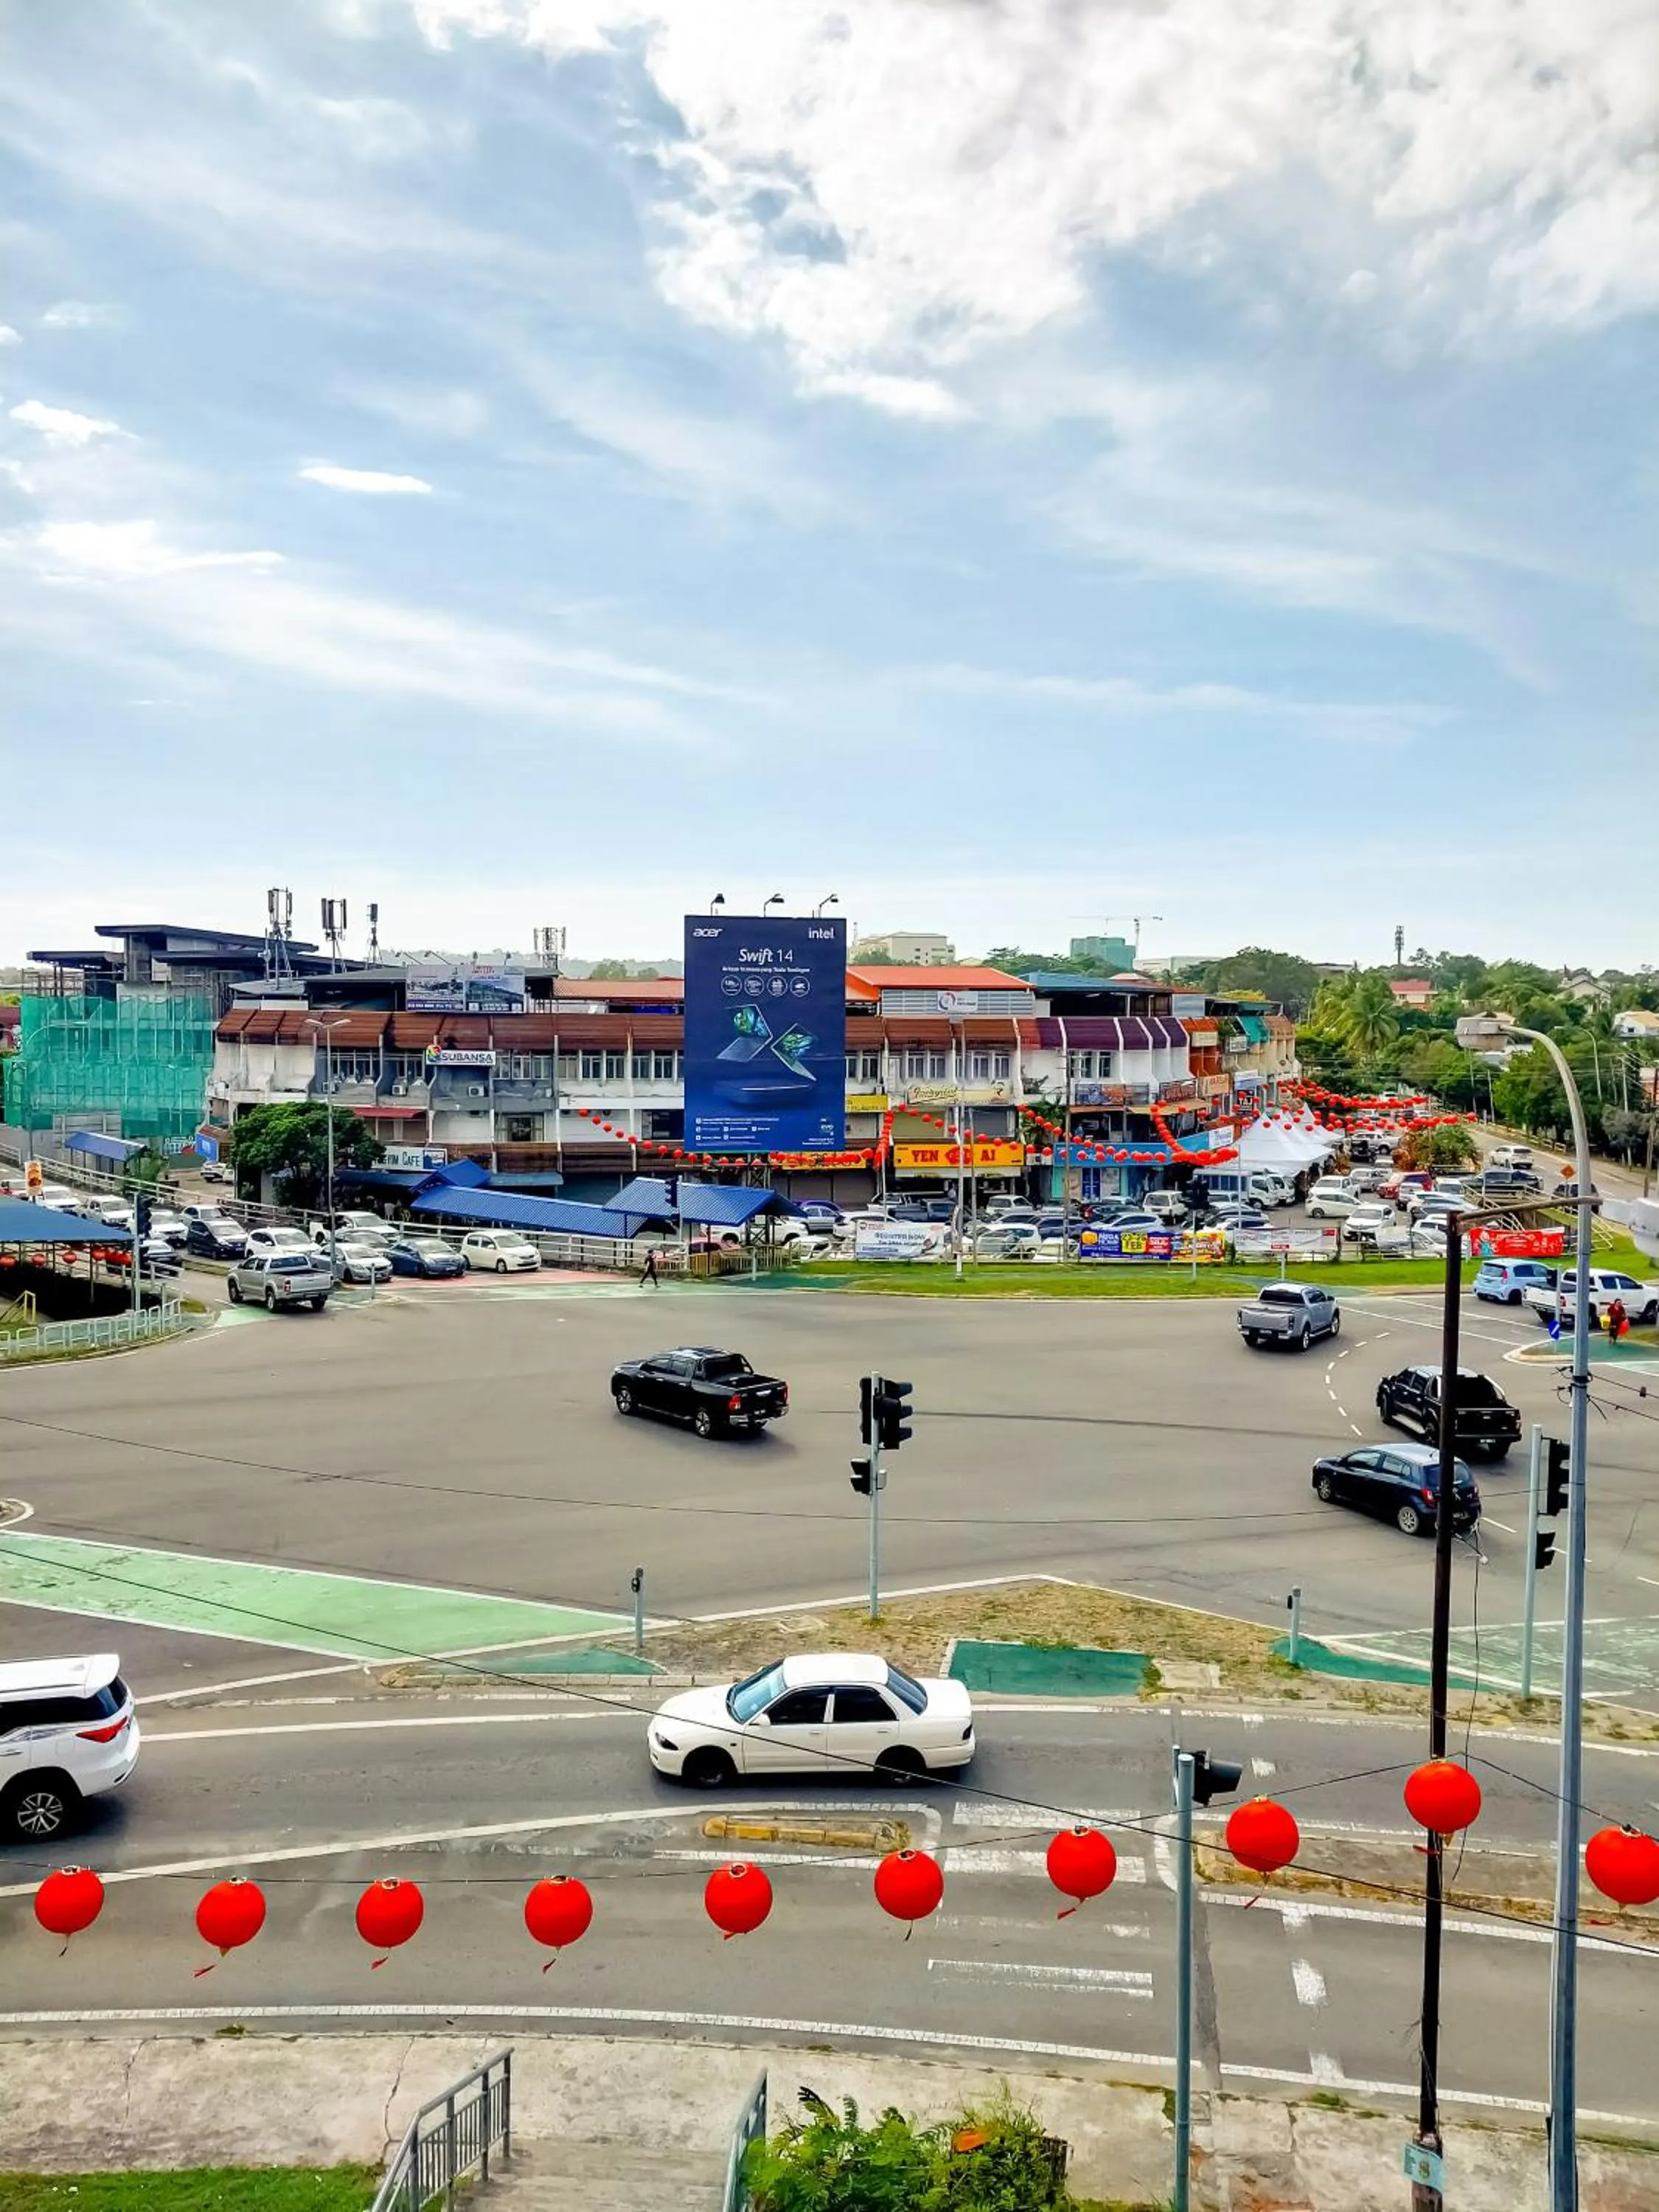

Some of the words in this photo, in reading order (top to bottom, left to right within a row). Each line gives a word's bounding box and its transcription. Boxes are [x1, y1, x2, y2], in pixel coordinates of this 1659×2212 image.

[693, 928, 723, 938] acer
[808, 928, 834, 939] intel
[739, 948, 773, 964] Swift
[776, 949, 793, 962] 14
[442, 1052, 493, 1062] SUBANSA
[402, 1151, 420, 1166] CAFE
[911, 1150, 939, 1163] YEN
[980, 1150, 996, 1161] AI
[1126, 1241, 1142, 1250] FEB
